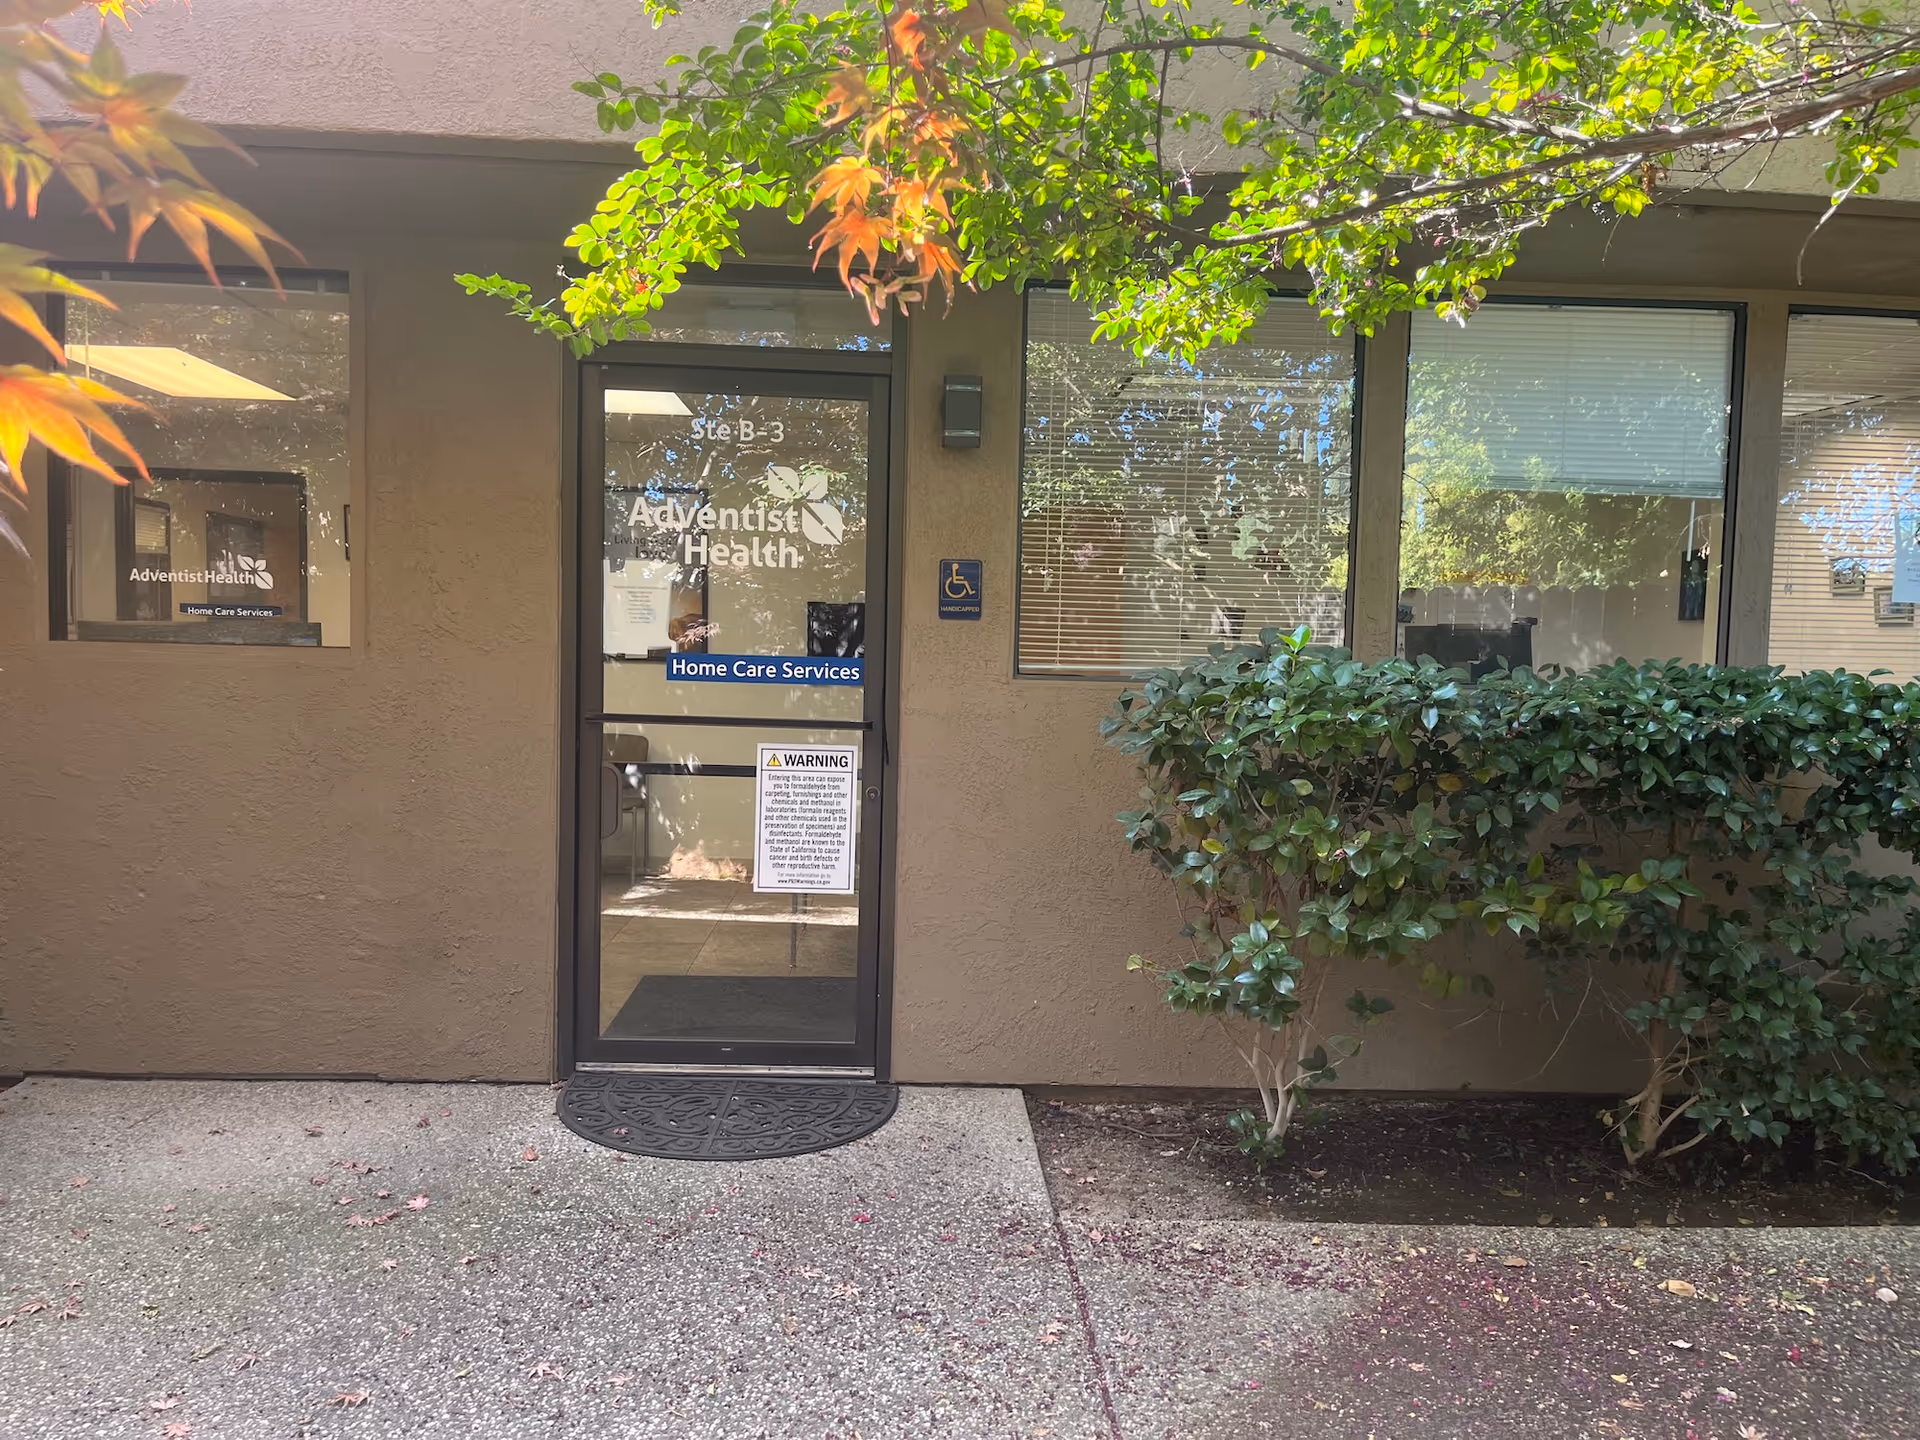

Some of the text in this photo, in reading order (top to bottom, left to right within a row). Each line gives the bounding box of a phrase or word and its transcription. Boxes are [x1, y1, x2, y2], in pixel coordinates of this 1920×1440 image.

[691, 418, 785, 443] Ste B-3
[628, 497, 798, 532] Adventist
[684, 535, 798, 568] Health
[129, 568, 254, 584] Adventist Health
[188, 607, 273, 617] Home Care Services
[672, 659, 860, 680] Home Care Services
[784, 754, 848, 767] WARNING
[768, 774, 790, 782] Entering
[793, 791, 821, 799] furnishings
